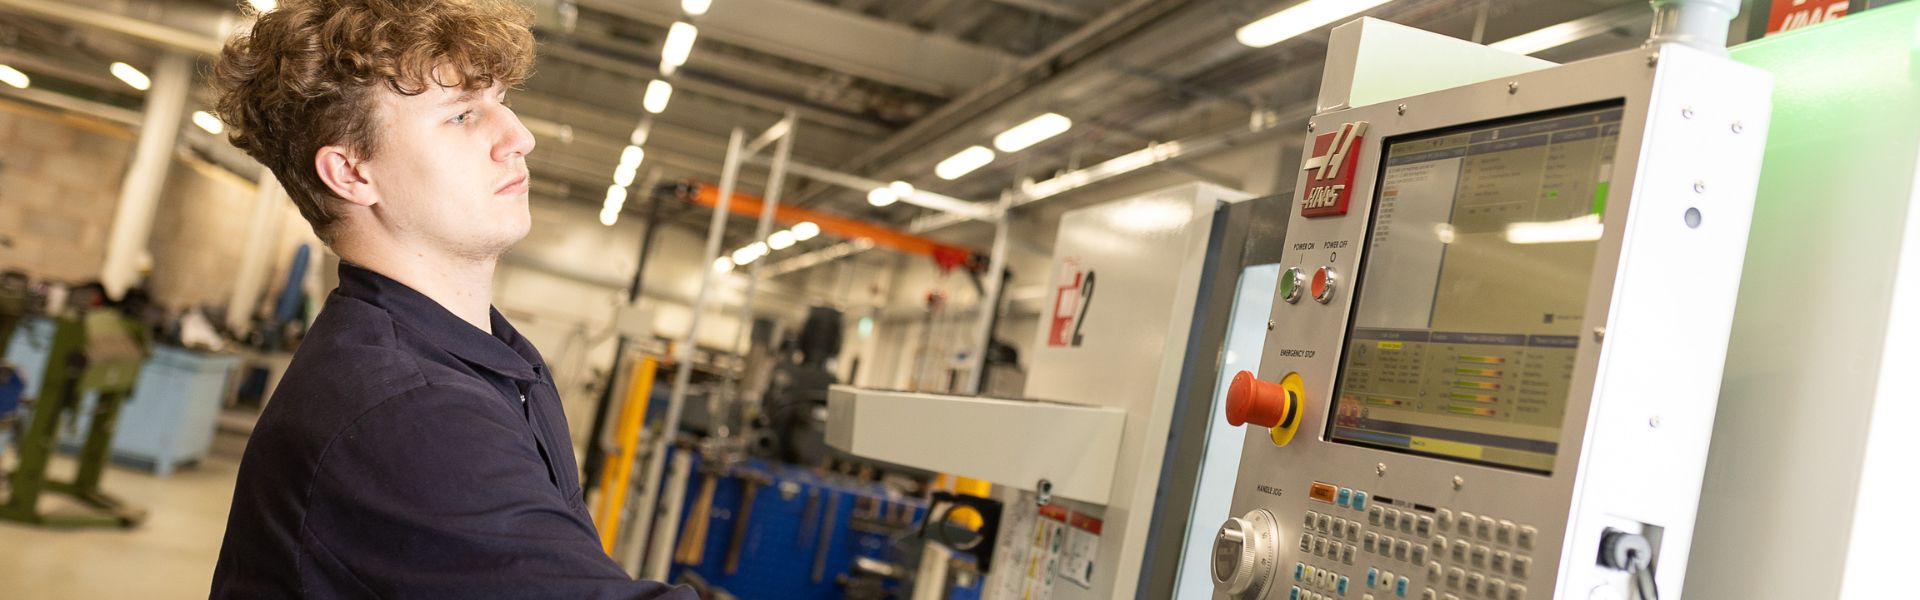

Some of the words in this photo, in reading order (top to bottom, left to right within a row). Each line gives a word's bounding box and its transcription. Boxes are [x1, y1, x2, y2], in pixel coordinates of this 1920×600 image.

[1301, 185, 1345, 208] HAAS
[1308, 242, 1315, 250] ON
[1324, 241, 1338, 249] POWER
[1339, 240, 1348, 248] OFF
[1280, 349, 1304, 357] EMERGENCY
[1304, 350, 1316, 358] STOP
[1257, 484, 1272, 495] HANDLE
[1272, 487, 1282, 497] JOG
